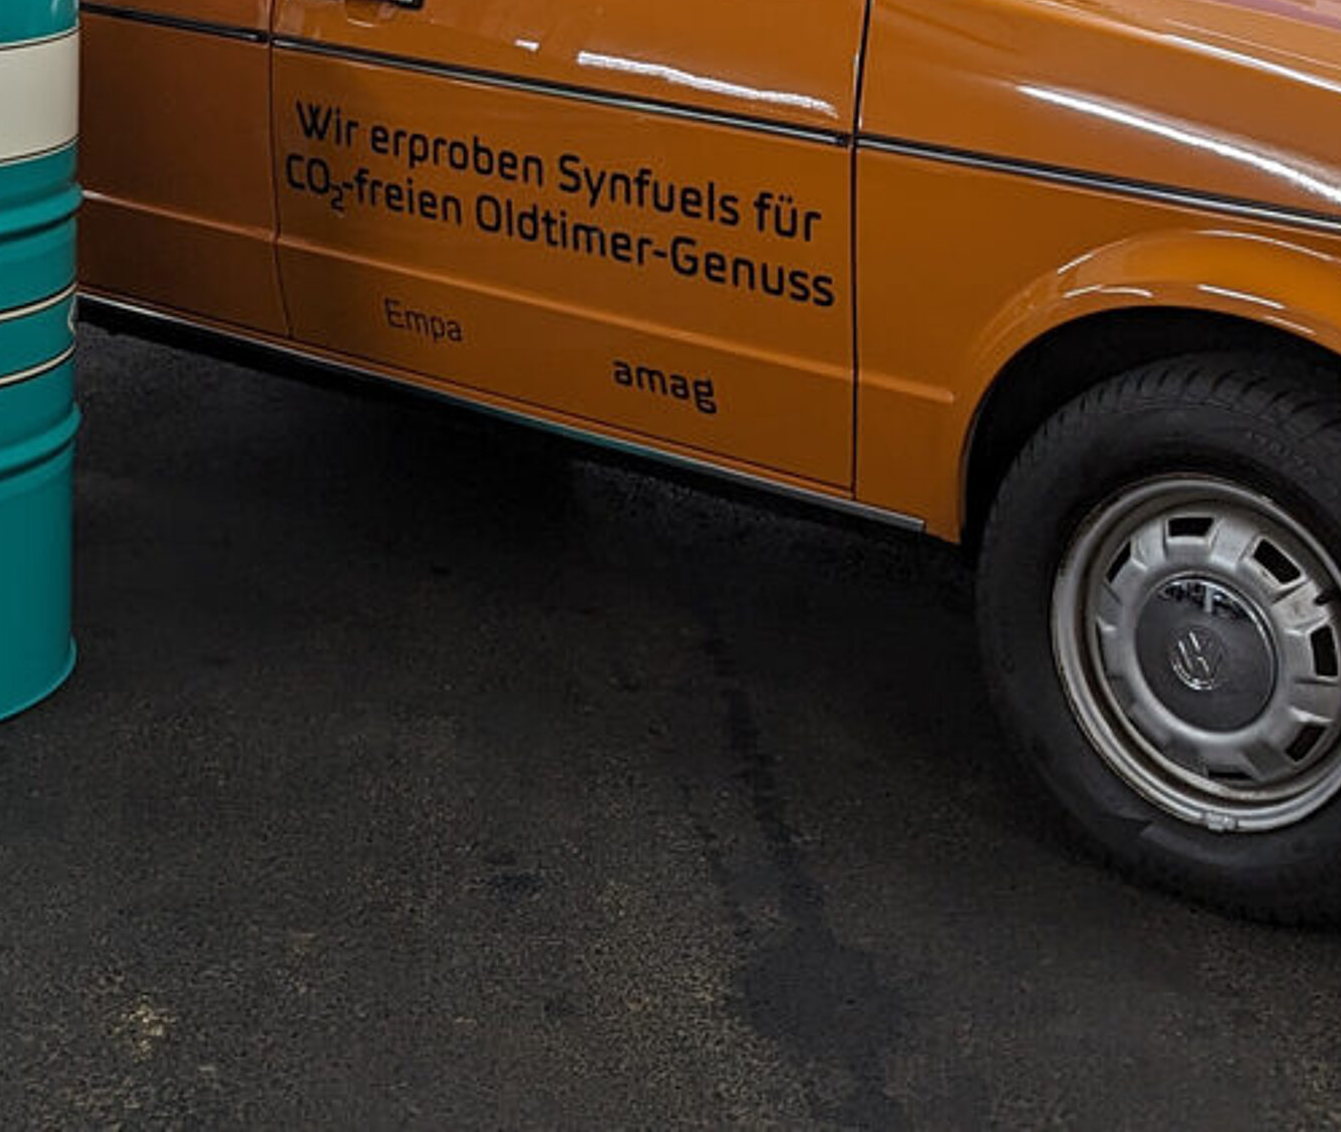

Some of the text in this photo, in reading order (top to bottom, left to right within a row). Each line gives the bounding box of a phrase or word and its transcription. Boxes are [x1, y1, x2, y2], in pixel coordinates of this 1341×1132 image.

[295, 100, 822, 243] Wir erproben Synfuels für
[475, 194, 836, 308] Oldtimer-Genuss
[384, 297, 463, 345] Empa
[613, 359, 719, 416] amag
